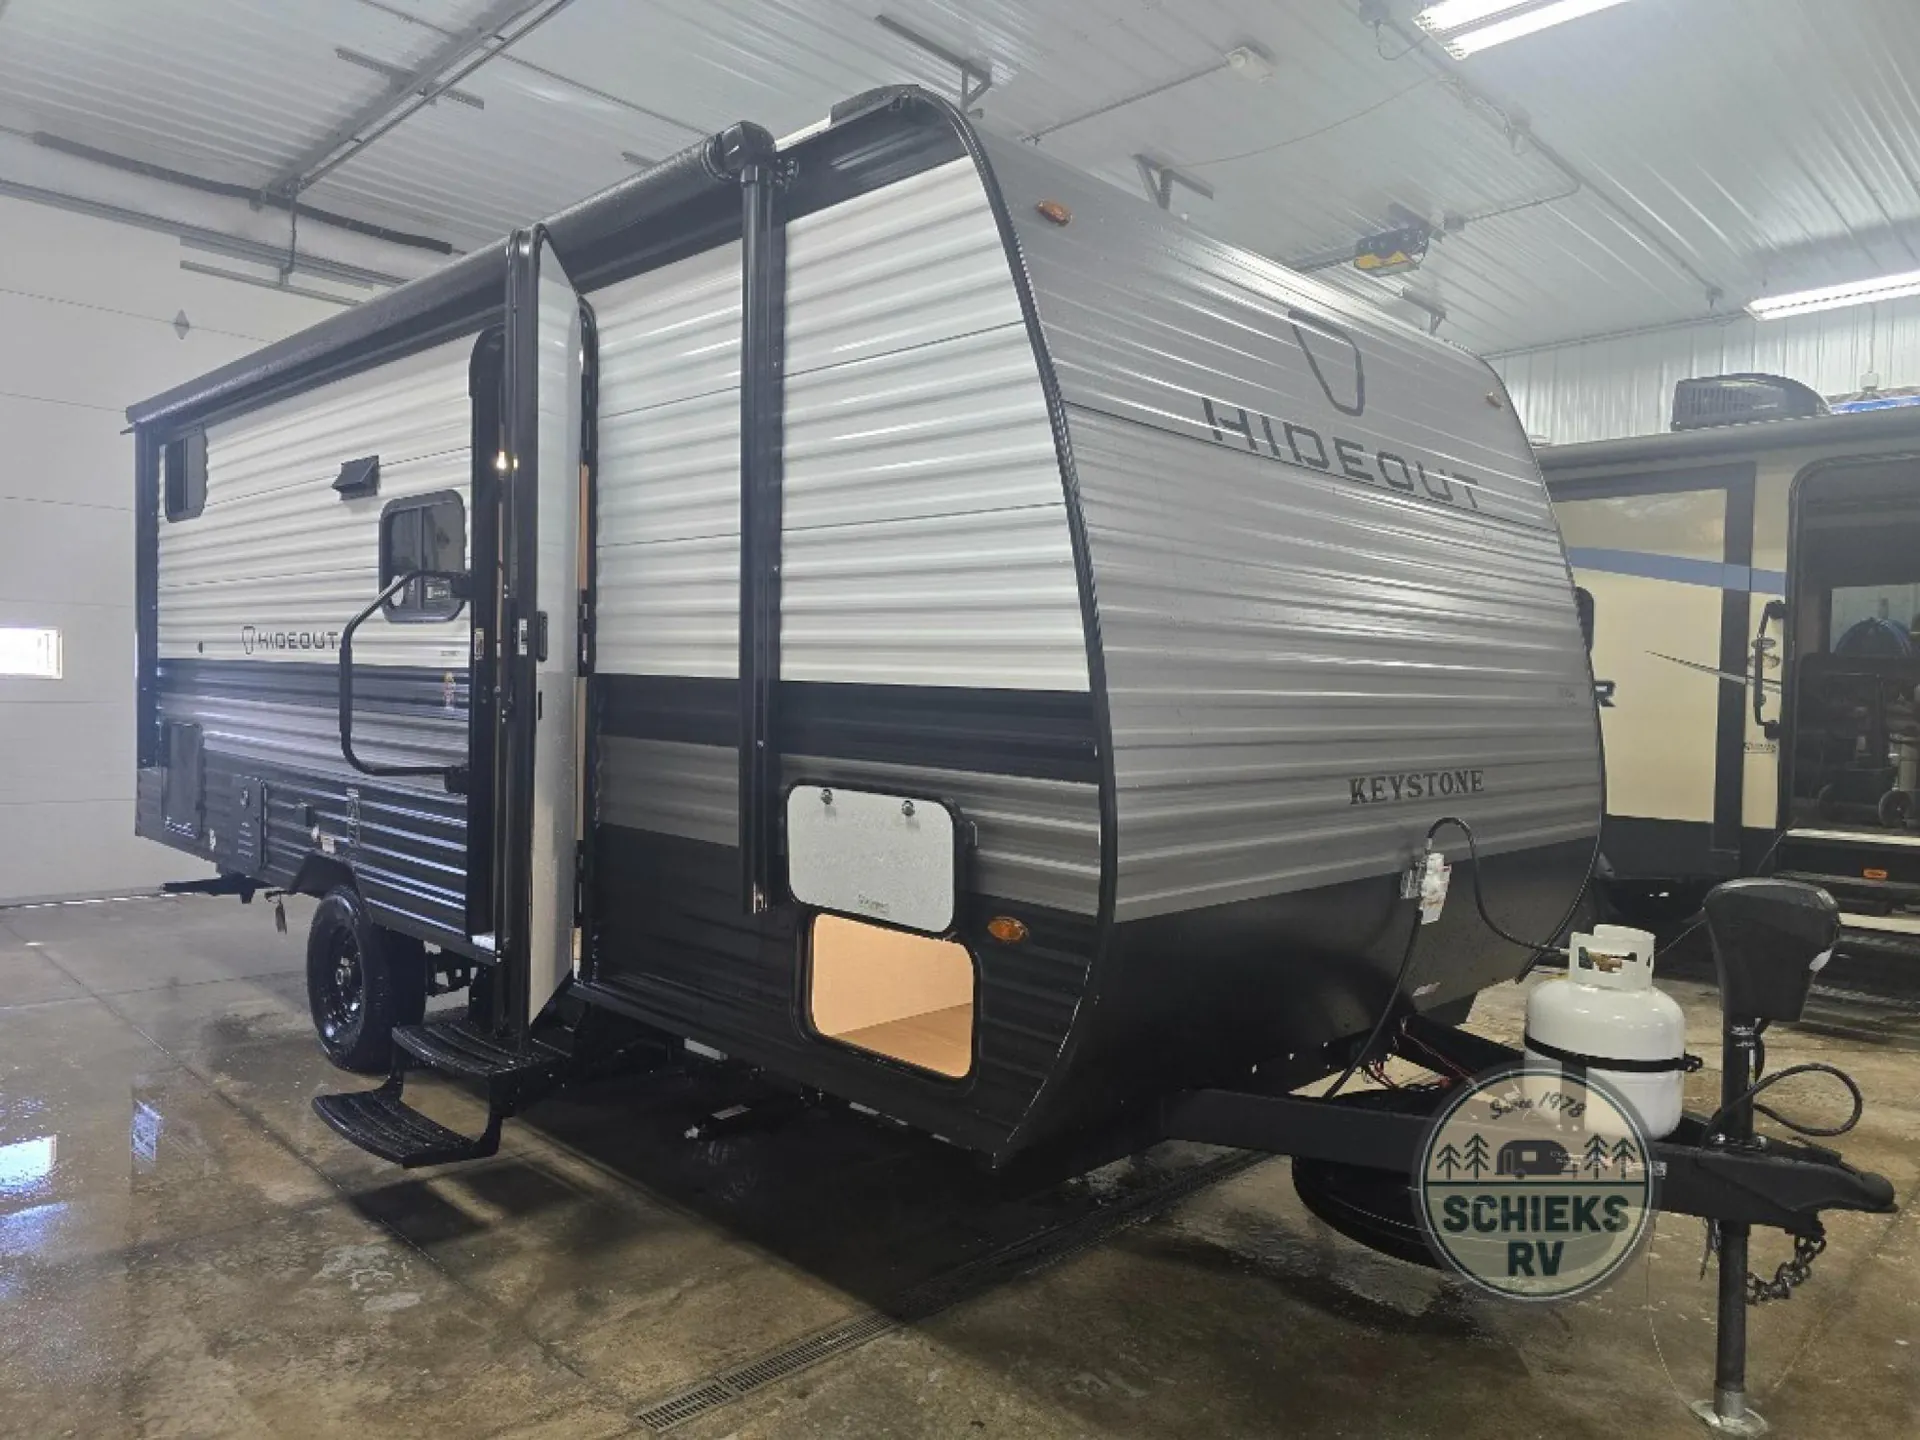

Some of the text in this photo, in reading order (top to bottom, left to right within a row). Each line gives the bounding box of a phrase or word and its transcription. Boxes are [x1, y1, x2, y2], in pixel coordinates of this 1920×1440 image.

[1201, 397, 1479, 509] HIDEOUT
[258, 631, 338, 650] HIDEOUT
[1348, 769, 1485, 805] KEYSTONE
